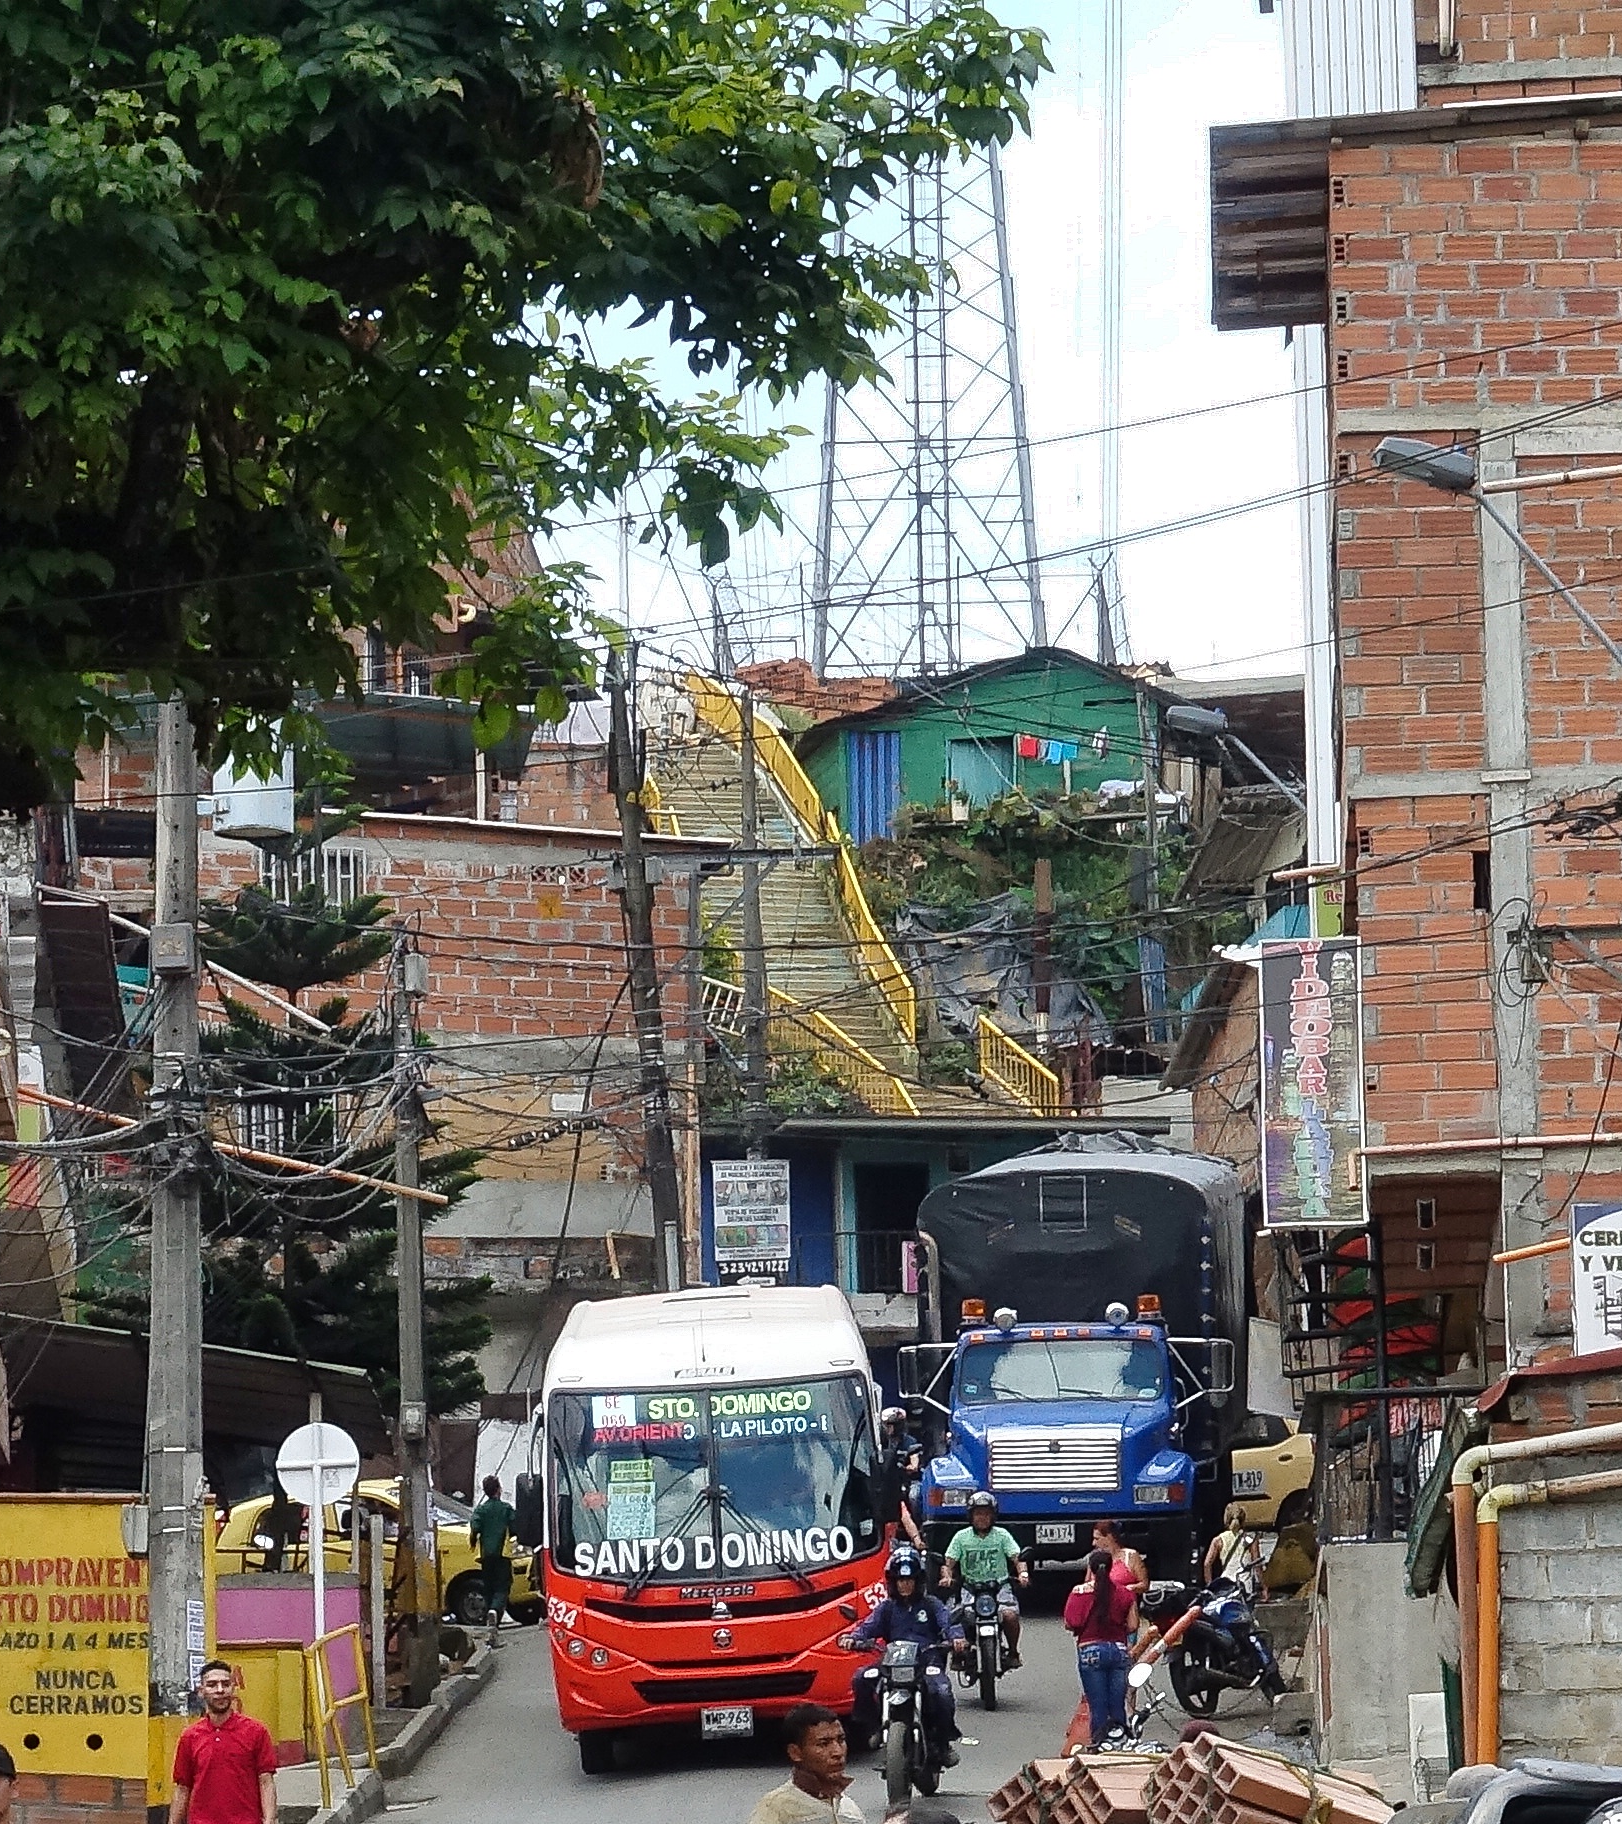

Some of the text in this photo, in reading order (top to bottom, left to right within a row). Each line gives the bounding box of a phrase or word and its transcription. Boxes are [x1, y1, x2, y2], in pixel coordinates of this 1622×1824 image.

[1289, 940, 1333, 1095] VIDEOBAR
[1580, 1255, 1593, 1272] Y
[648, 1390, 812, 1420] STO. DOMINGO
[745, 1417, 805, 1437] PILOTO
[574, 1525, 854, 1577] SANTO DOMINGO
[681, 1586, 755, 1600] Marcopolo
[864, 1582, 889, 1610] 53
[548, 1596, 578, 1629] 534
[62, 1632, 76, 1650] A
[85, 1633, 98, 1649] 4
[36, 1671, 115, 1690] NUNCA
[10, 1695, 143, 1715] CERRAMOS
